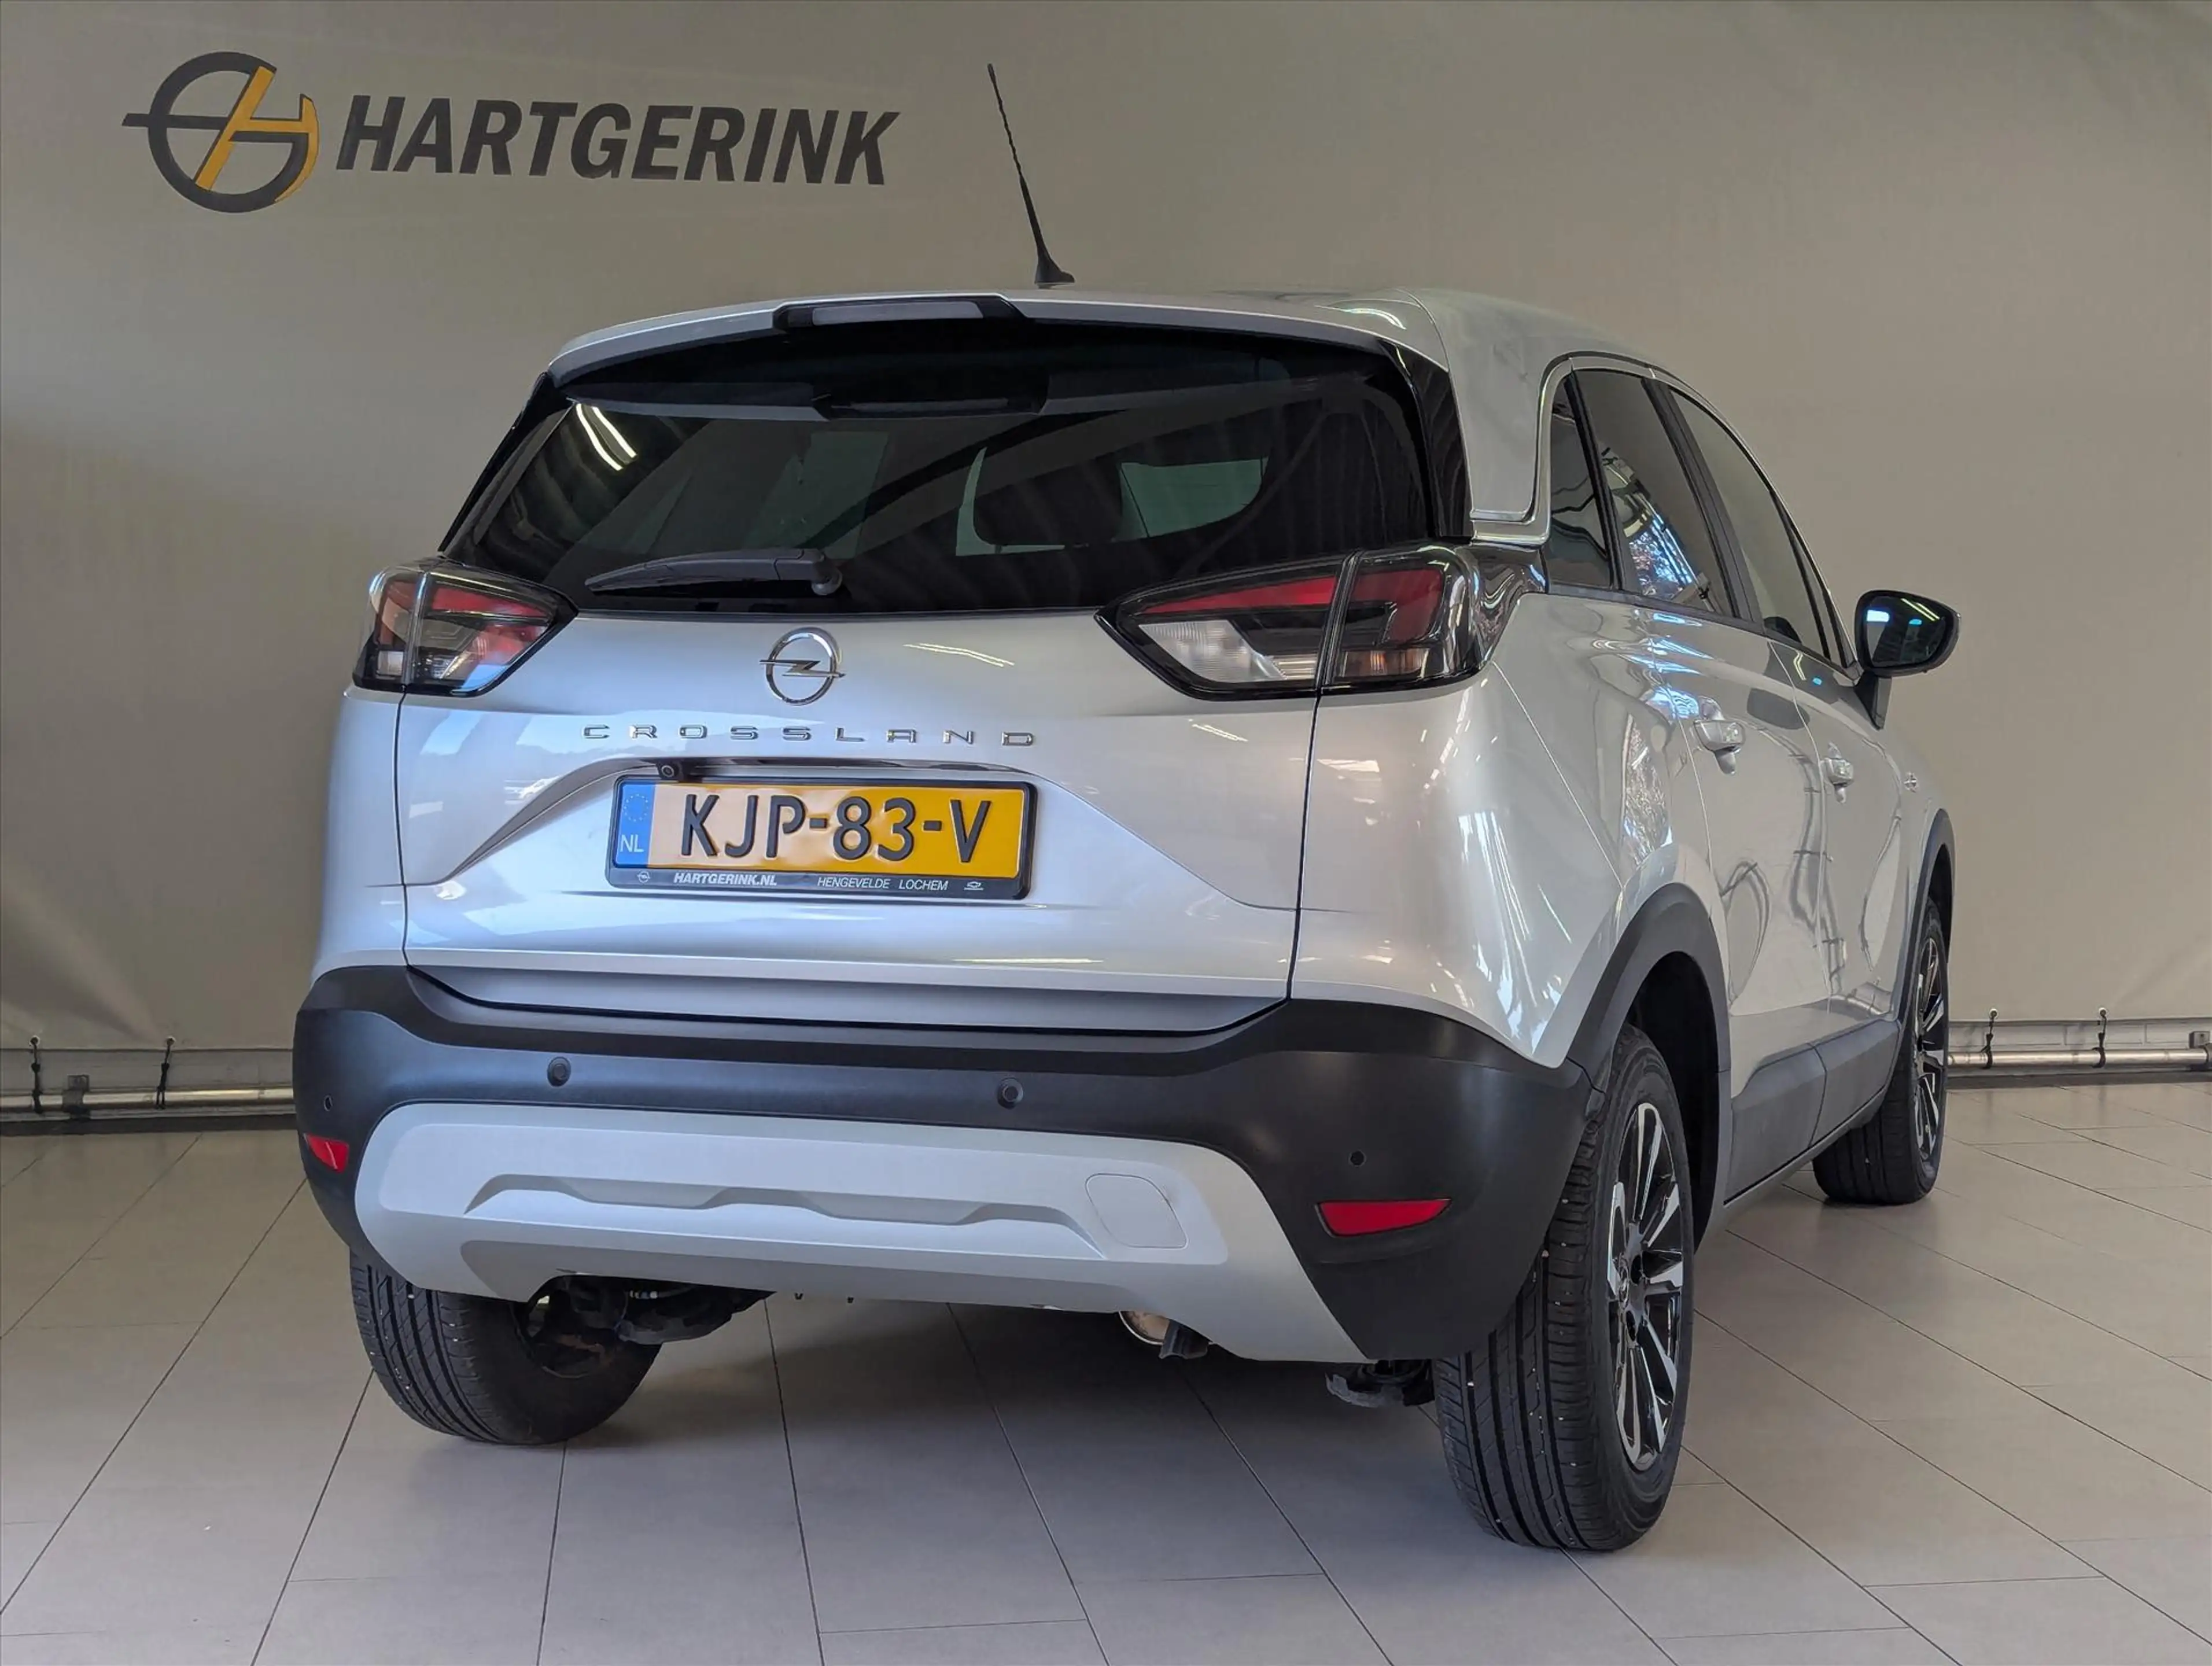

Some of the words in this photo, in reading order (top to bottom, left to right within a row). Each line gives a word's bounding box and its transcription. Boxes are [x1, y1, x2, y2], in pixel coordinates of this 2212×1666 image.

[336, 94, 901, 186] HARTGERINK
[581, 724, 1034, 746] CROSSLAND
[680, 794, 993, 863] KJP-83-V
[620, 834, 644, 853] NL
[673, 871, 777, 886] HARTGERINK.NL
[817, 876, 891, 889] HENGEVELDE
[898, 879, 949, 891] LOCHEM
